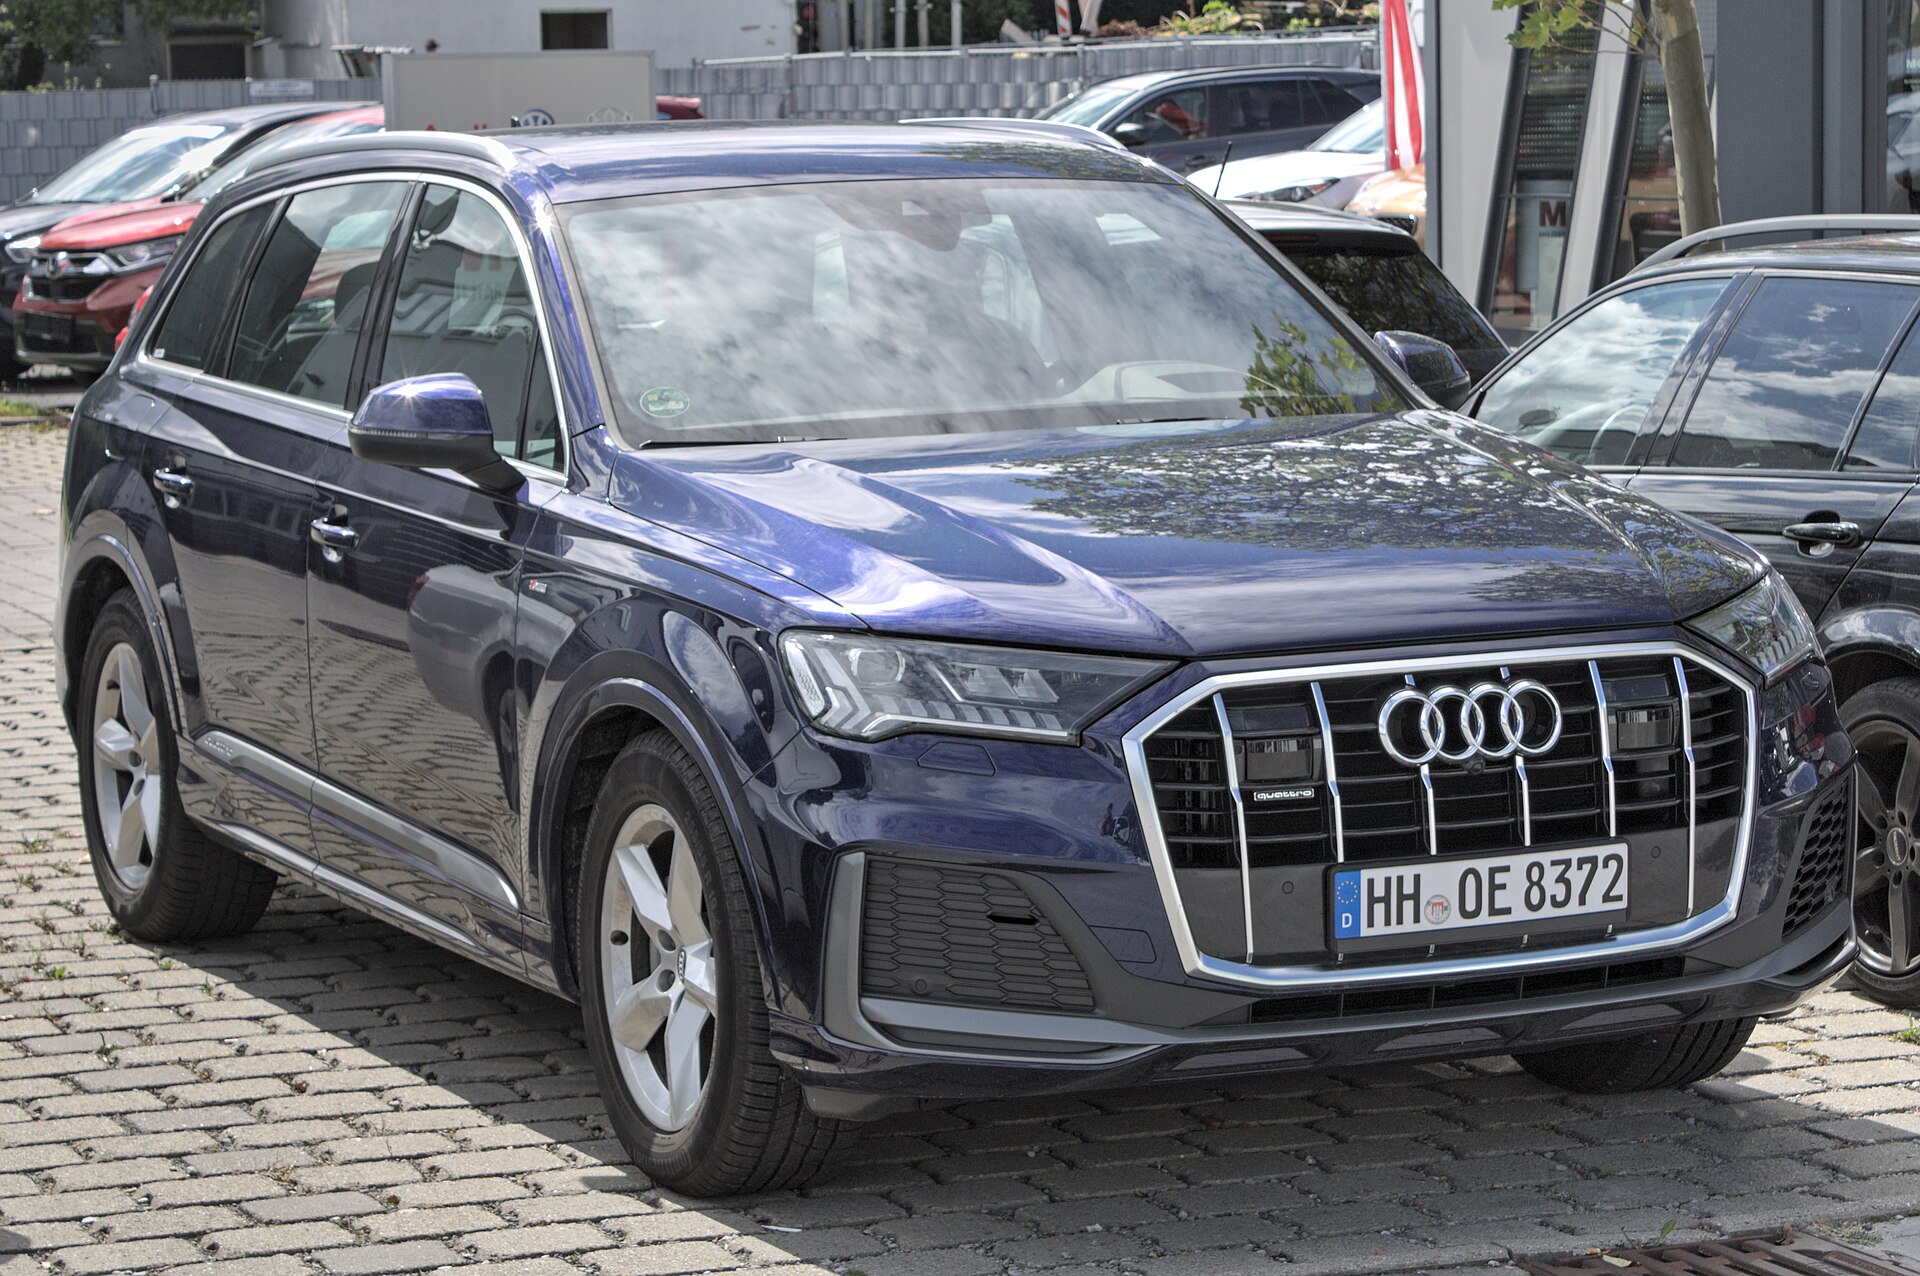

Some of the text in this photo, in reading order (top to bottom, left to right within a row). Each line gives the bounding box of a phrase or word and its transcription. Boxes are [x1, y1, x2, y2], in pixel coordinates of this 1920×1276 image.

[1256, 789, 1312, 800] quattro
[1366, 853, 1624, 928] HH OE 8372
[1341, 913, 1352, 928] D
